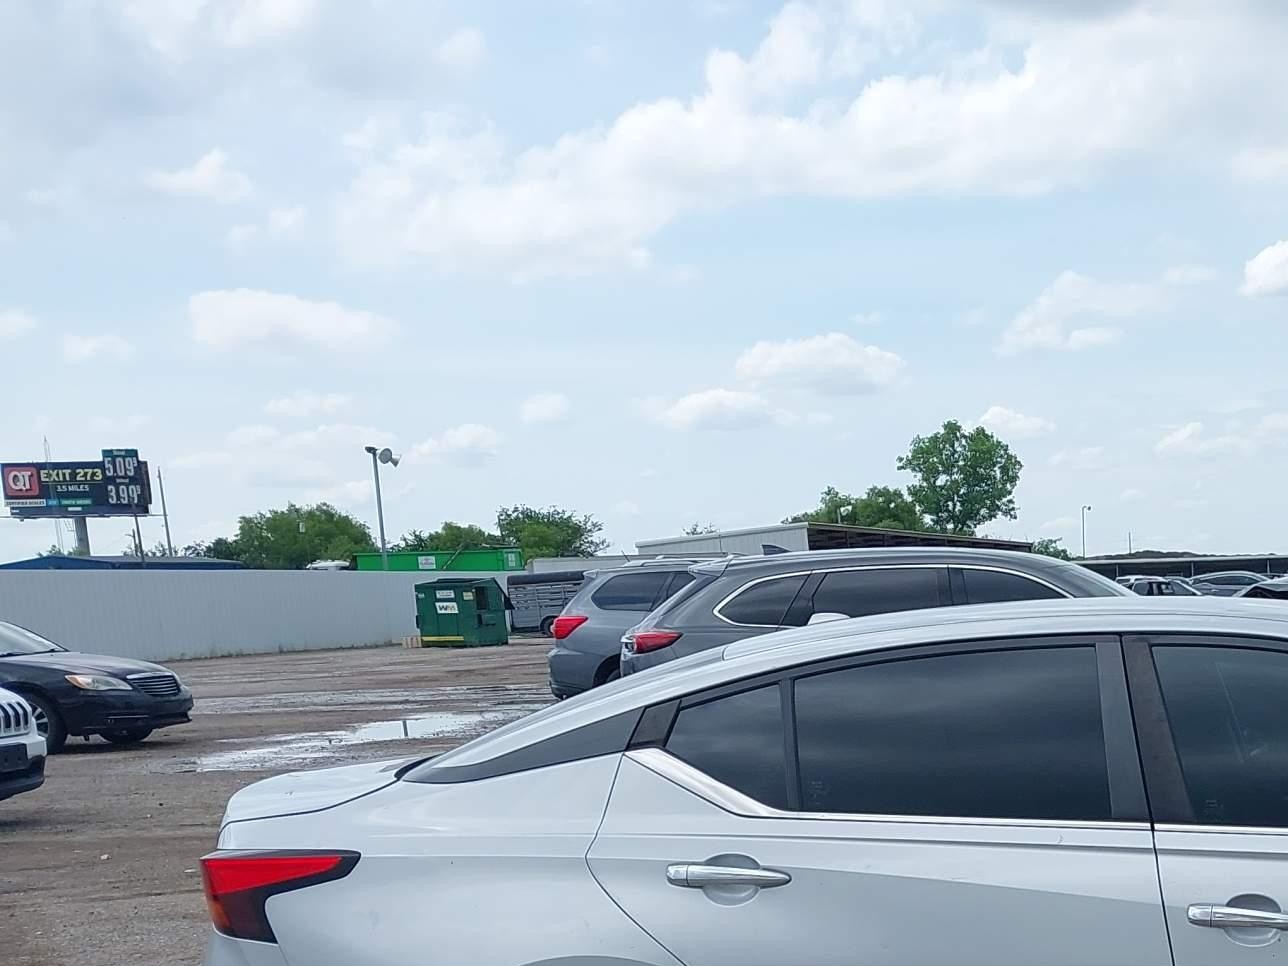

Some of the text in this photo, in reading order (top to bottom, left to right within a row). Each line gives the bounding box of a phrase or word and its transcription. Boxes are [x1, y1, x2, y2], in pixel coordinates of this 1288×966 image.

[8, 471, 32, 491] QT
[40, 468, 103, 482] EXIT 273
